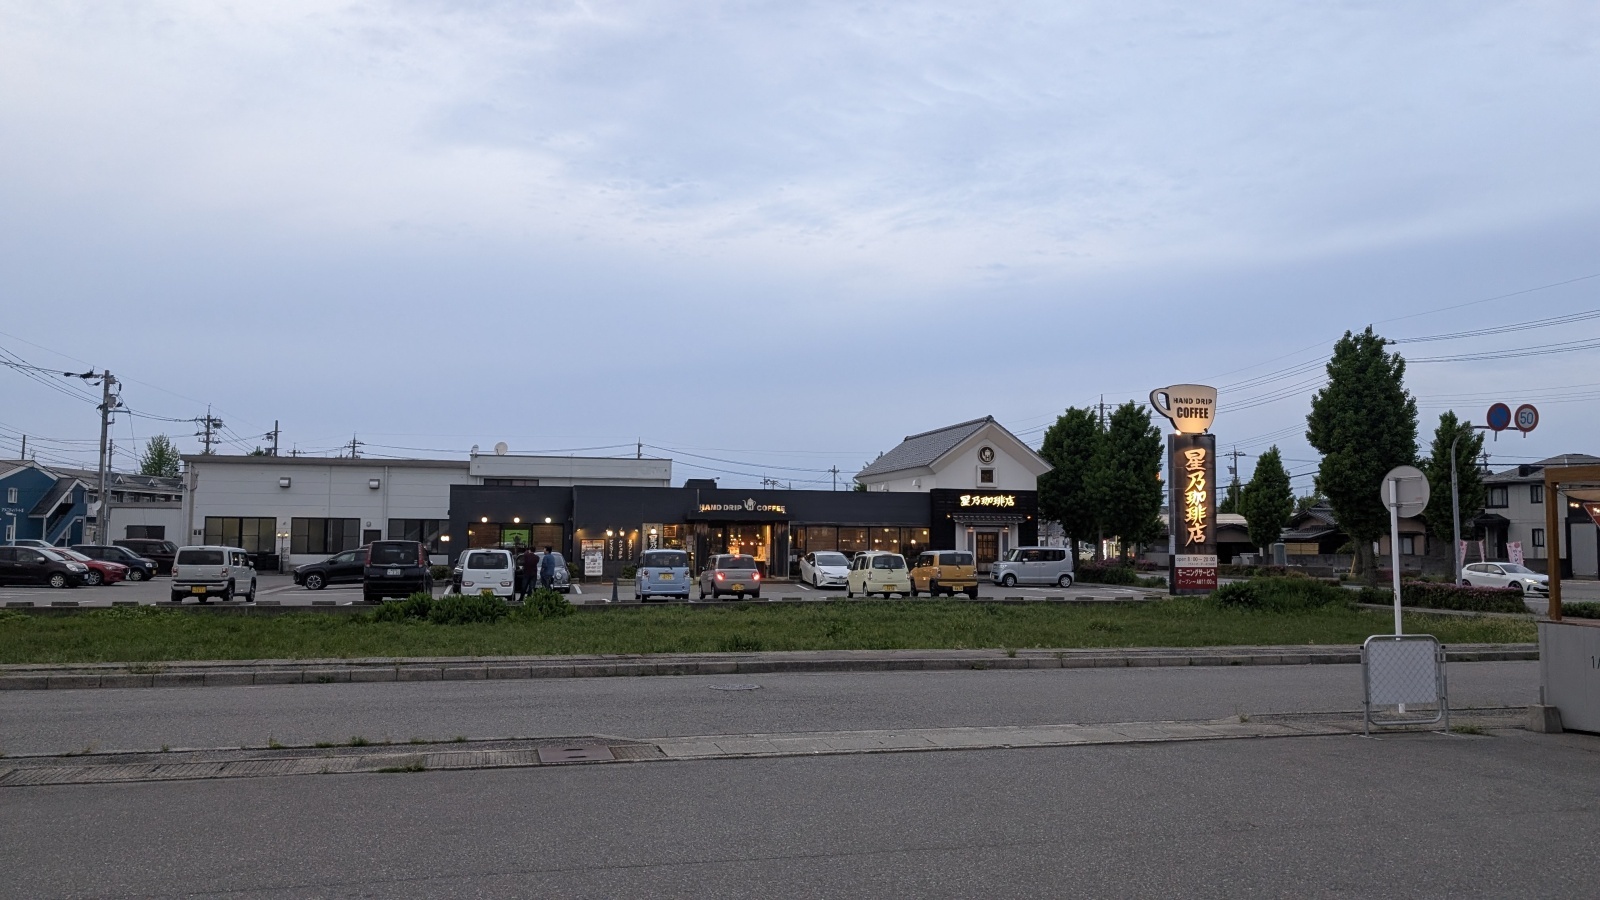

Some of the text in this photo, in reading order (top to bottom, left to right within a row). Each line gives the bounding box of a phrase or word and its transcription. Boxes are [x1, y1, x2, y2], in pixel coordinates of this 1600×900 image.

[1176, 406, 1209, 419] COFFEE
[1520, 411, 1534, 425] 50
[960, 494, 1015, 508] 星乃珈琲店
[1184, 448, 1207, 547] 星乃珈琲店
[699, 503, 722, 511] HAND
[1177, 568, 1216, 577] モーニングサービス
